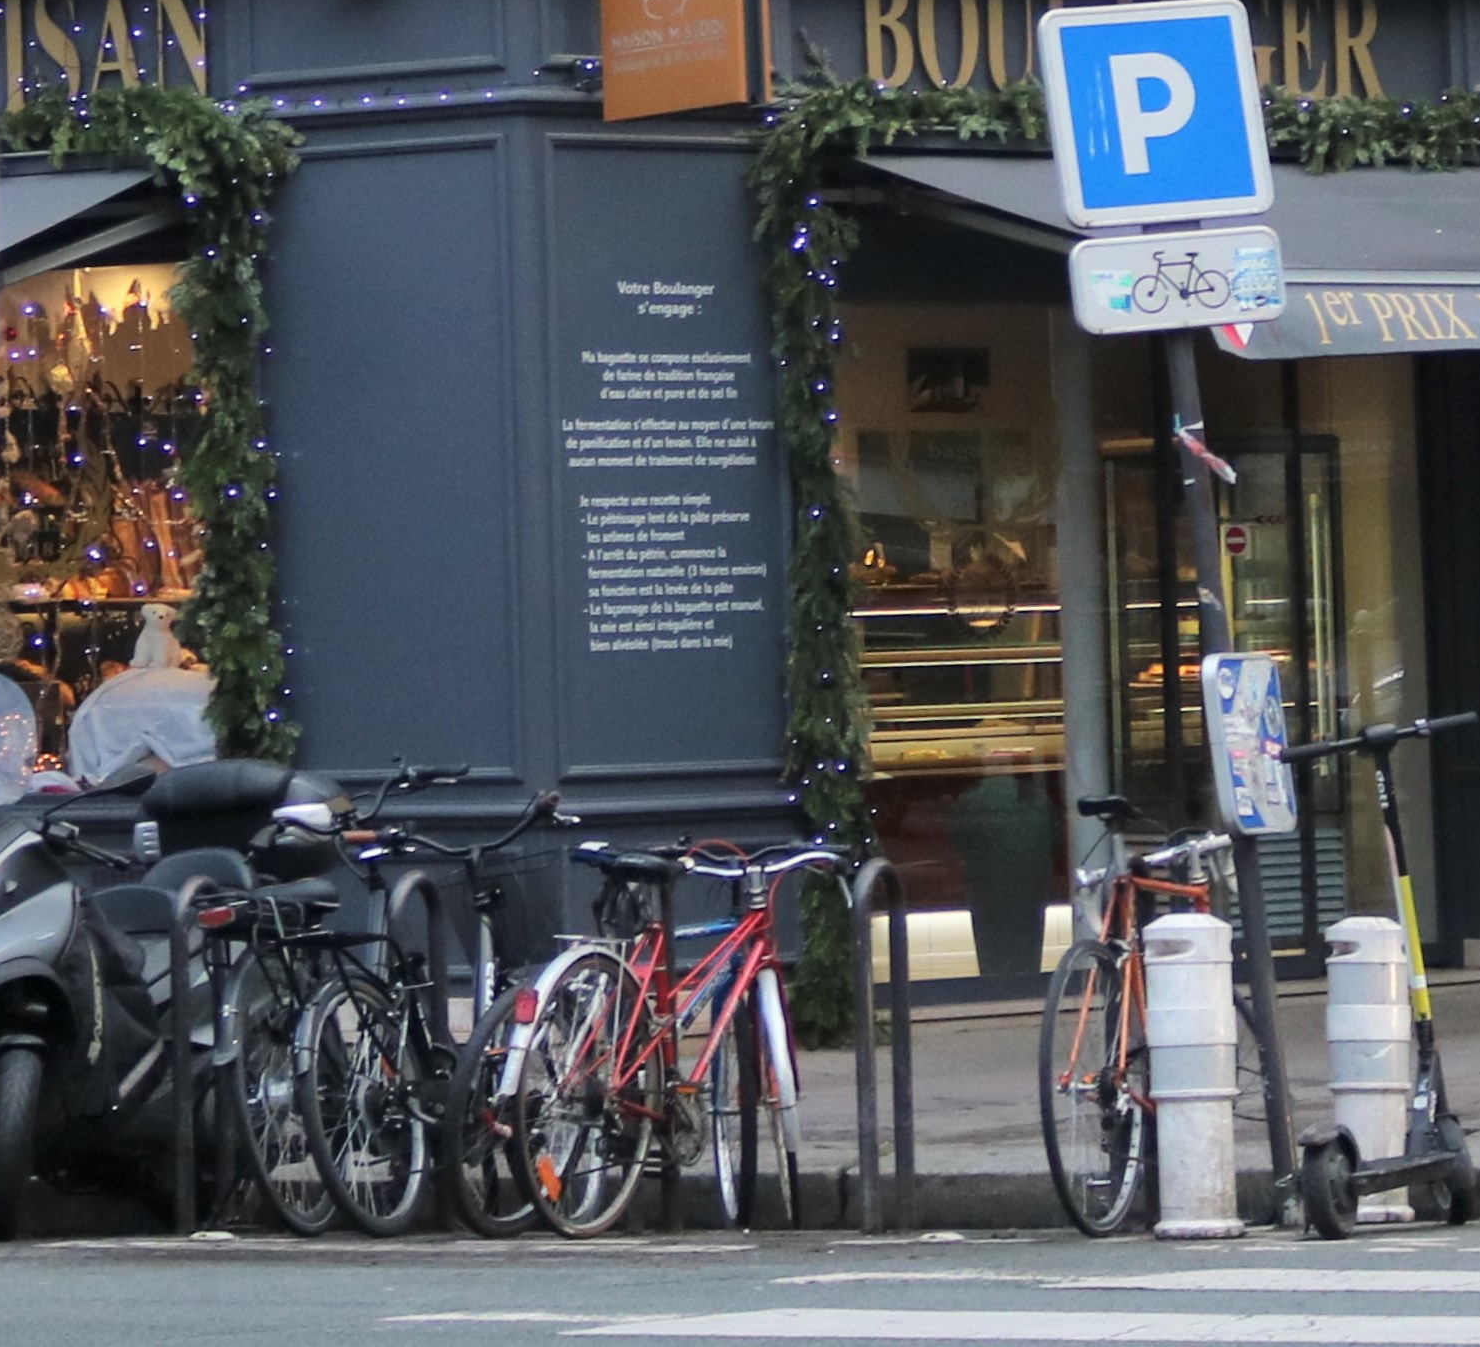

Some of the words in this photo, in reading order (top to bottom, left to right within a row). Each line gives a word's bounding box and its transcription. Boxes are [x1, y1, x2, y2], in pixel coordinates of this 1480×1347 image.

[1109, 52, 1196, 175] P
[617, 280, 650, 295] Votre
[652, 280, 714, 299] Boulanger
[637, 301, 694, 319] s'engage
[1305, 290, 1363, 345] 1er
[1363, 292, 1477, 342] PRIX
